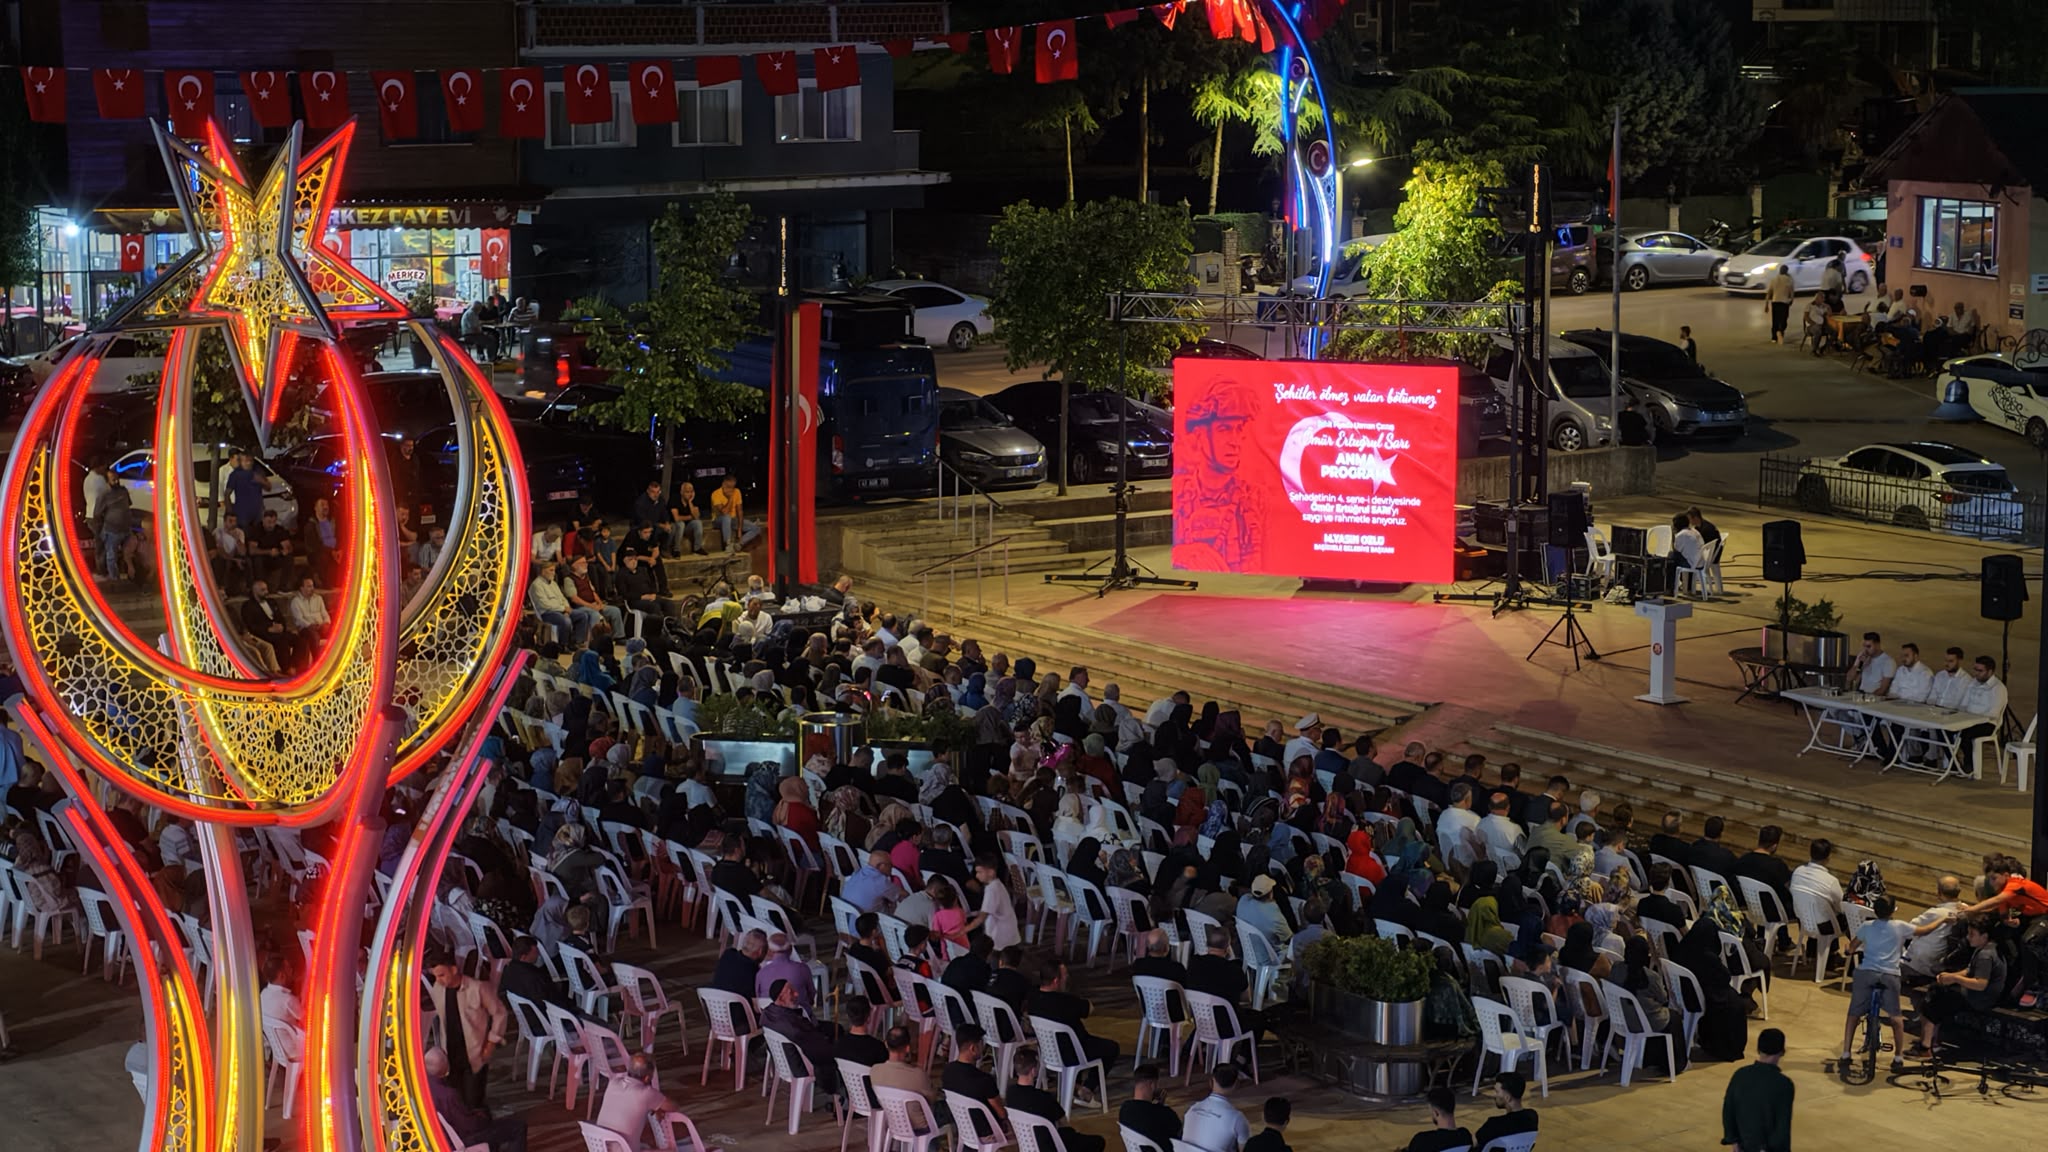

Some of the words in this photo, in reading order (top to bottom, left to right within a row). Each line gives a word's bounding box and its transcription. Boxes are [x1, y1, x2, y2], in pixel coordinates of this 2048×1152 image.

[436, 206, 471, 224] EVİ
[388, 270, 425, 282] MERKEZ
[1353, 389, 1385, 404] vatan
[1335, 430, 1384, 452] Ertuğrul
[1384, 432, 1410, 450] Sarı
[1335, 452, 1376, 465] ANMA
[1371, 495, 1422, 509] devriyesinde
[1302, 513, 1323, 524] saygı
[1323, 514, 1334, 523] ve
[1334, 513, 1370, 524] rahmetle
